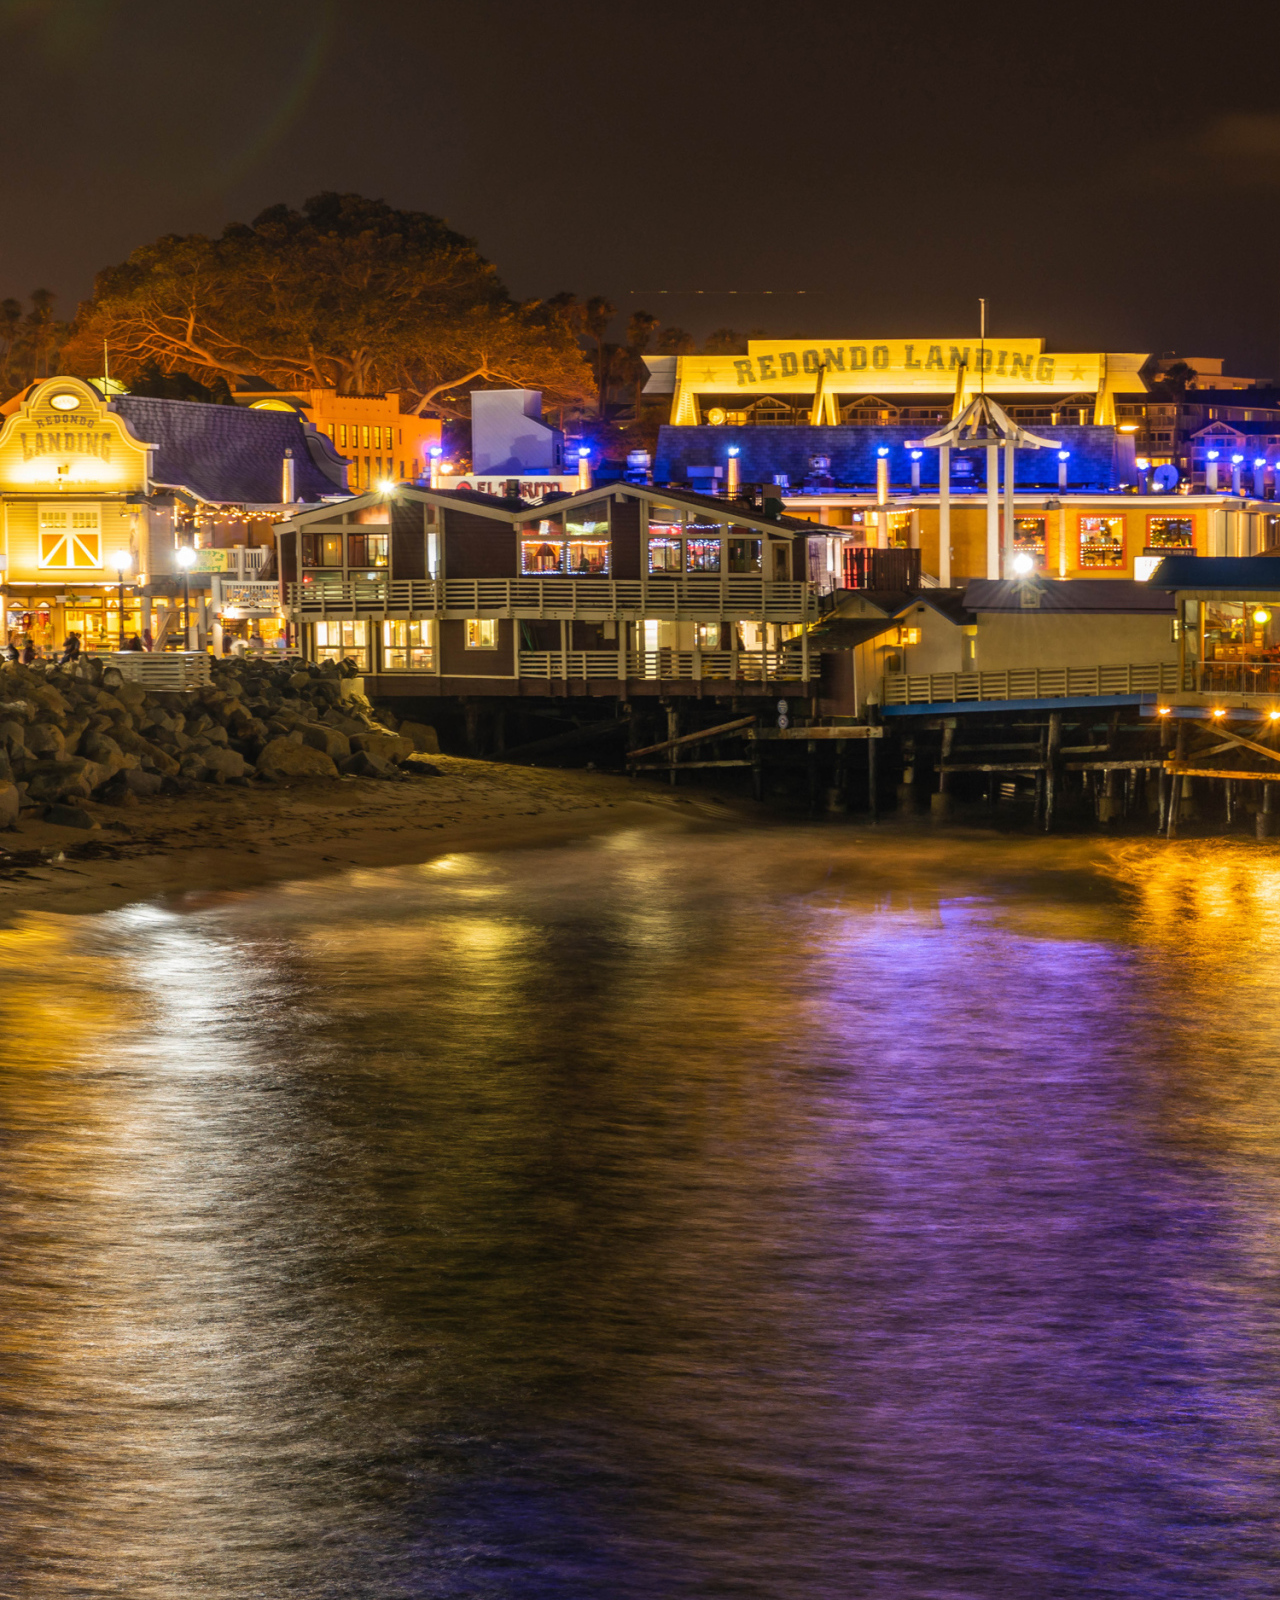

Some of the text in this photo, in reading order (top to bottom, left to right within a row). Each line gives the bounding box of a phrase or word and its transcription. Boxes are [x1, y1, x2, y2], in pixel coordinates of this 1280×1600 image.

[733, 344, 1056, 387] REDONDO LANDING
[36, 414, 95, 429] REDONDO
[20, 432, 112, 464] LANDING
[499, 481, 562, 499] TRITO
